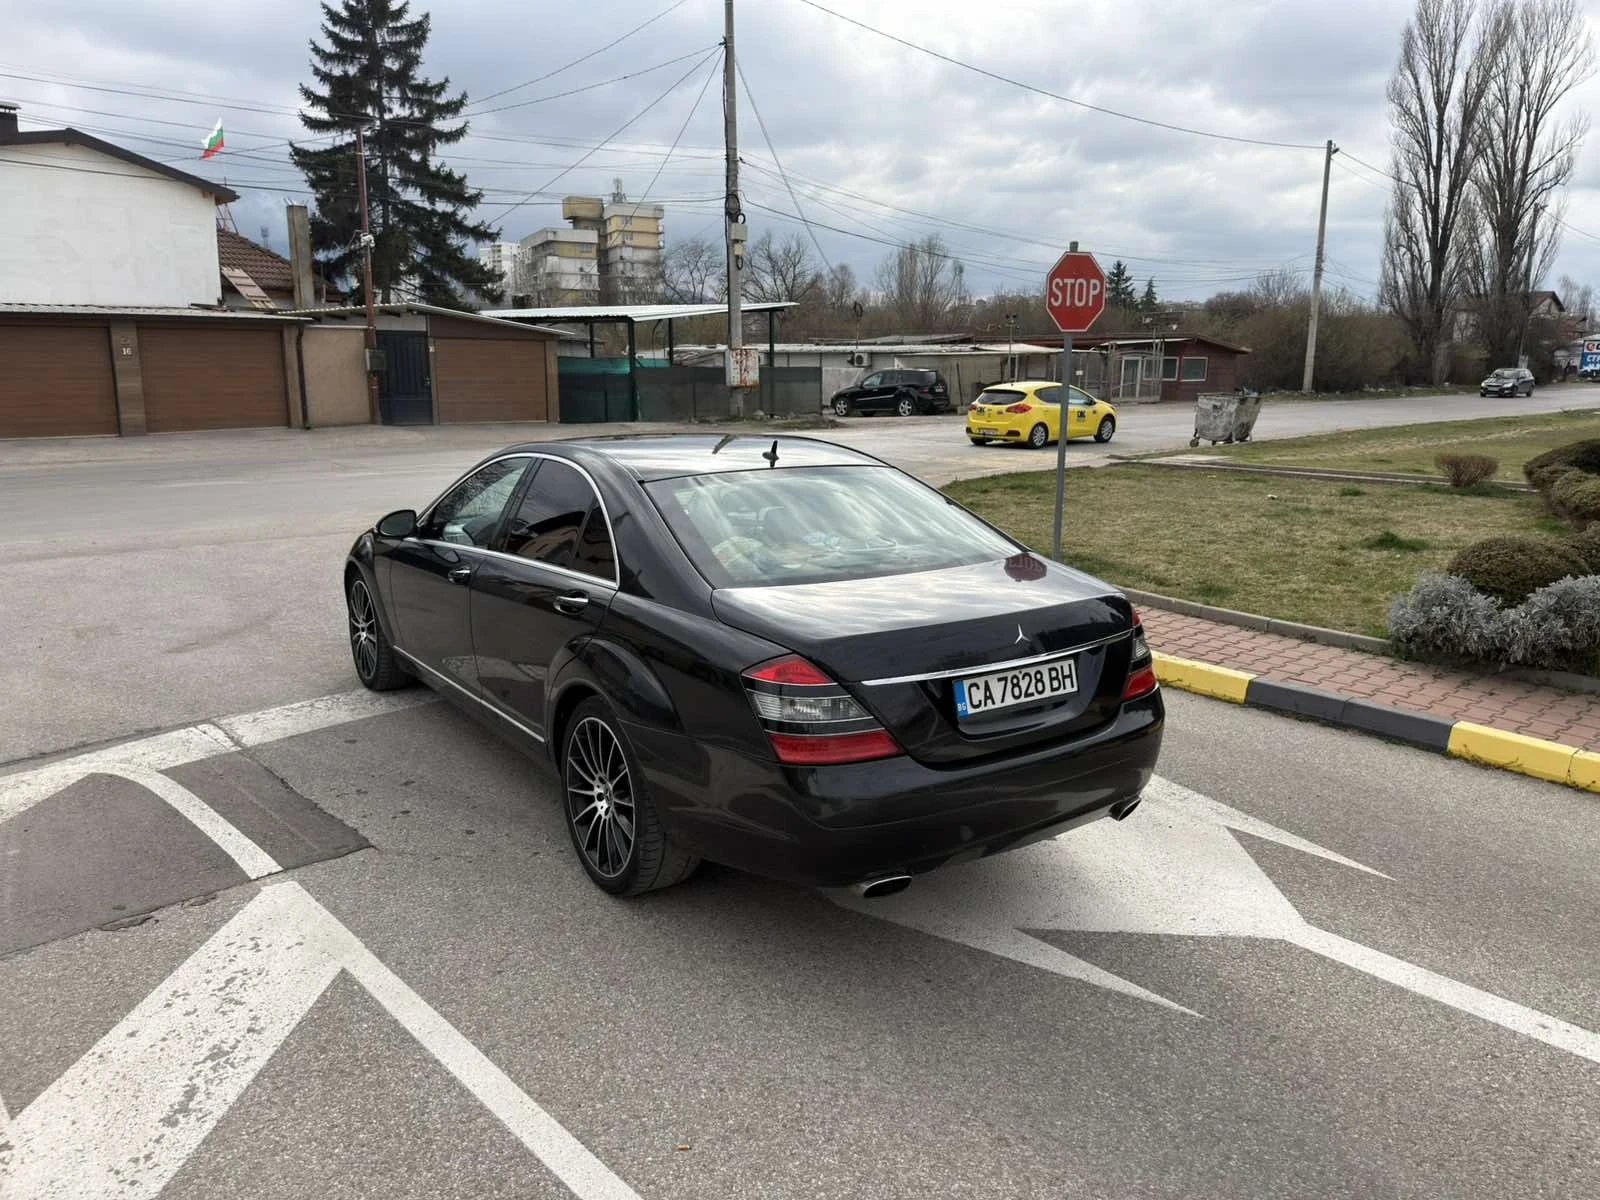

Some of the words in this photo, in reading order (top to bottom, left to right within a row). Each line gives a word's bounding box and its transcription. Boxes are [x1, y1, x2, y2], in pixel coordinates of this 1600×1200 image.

[1051, 278, 1100, 307] STOP
[967, 680, 996, 709] CA
[997, 670, 1046, 703] 7828
[1047, 663, 1075, 692] BH
[957, 702, 967, 711] BG
